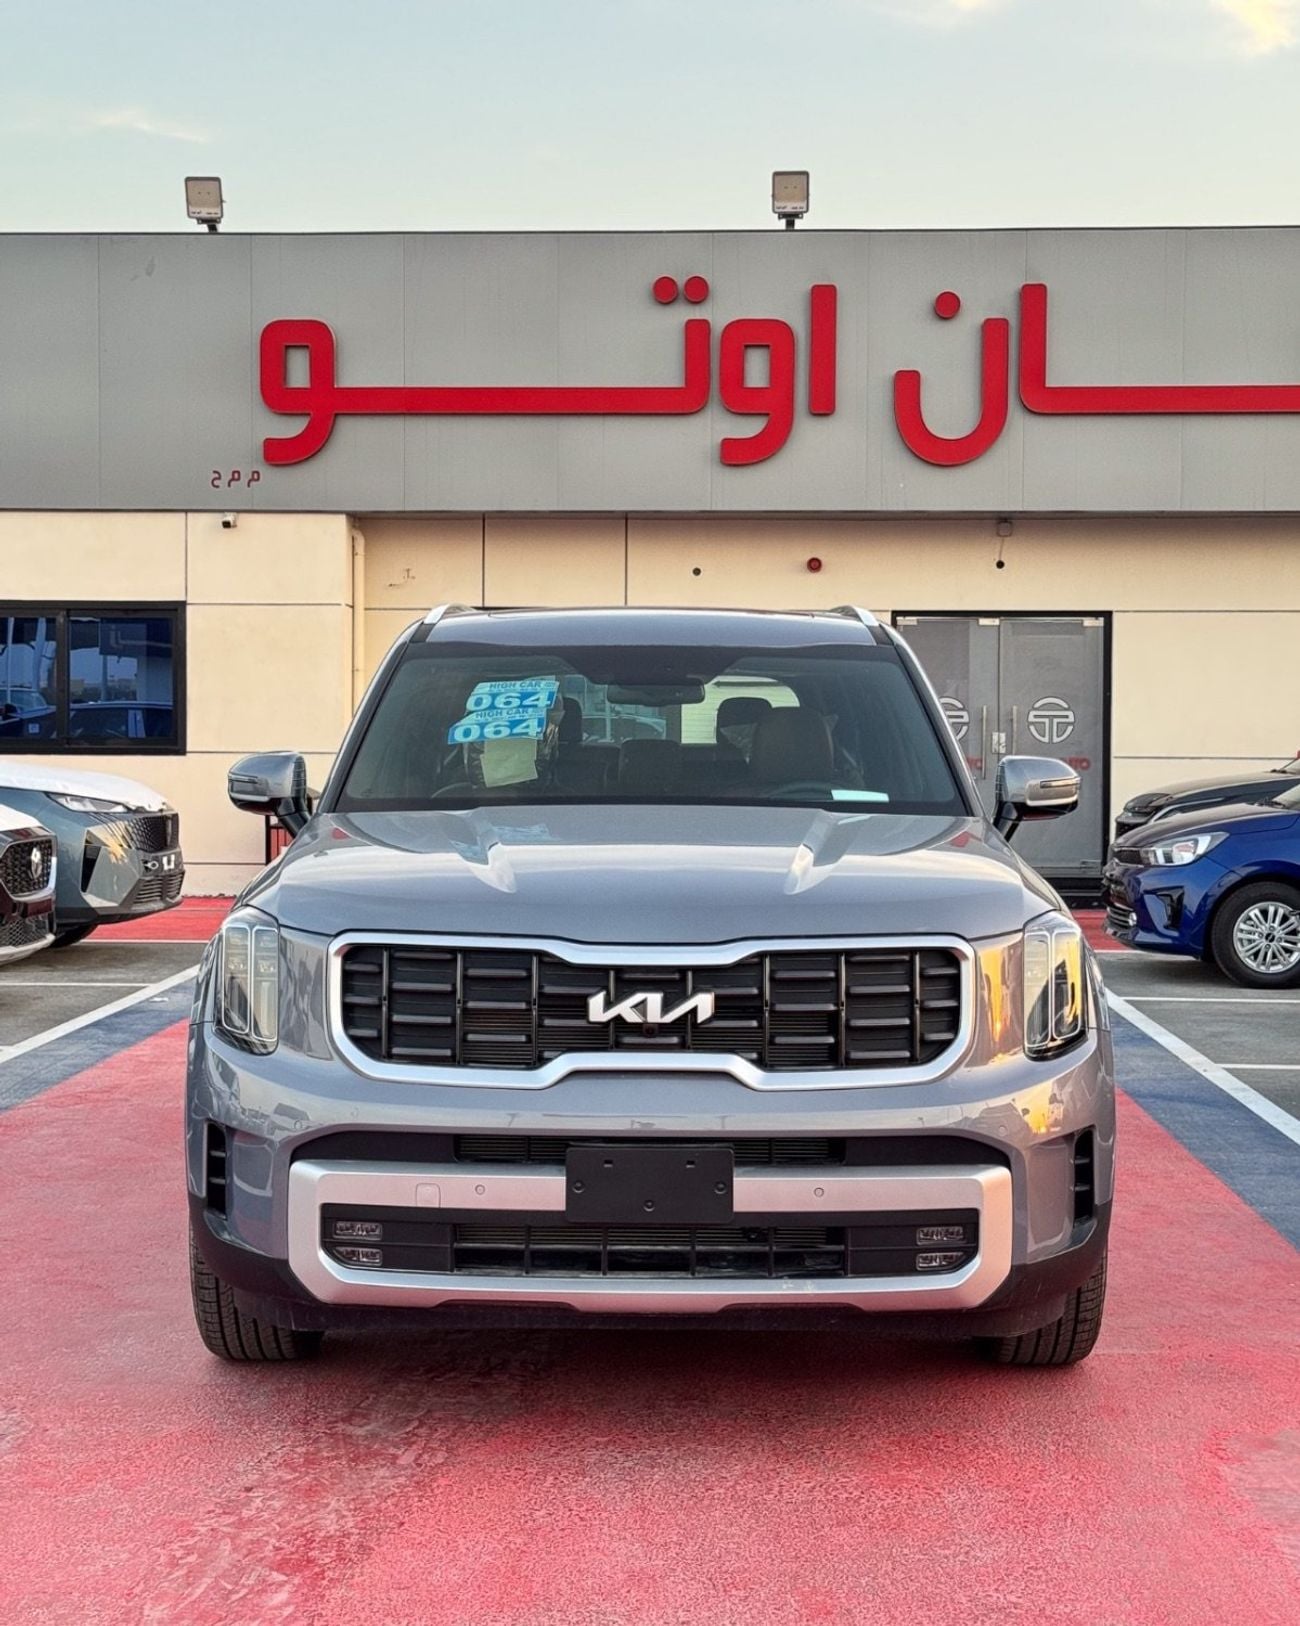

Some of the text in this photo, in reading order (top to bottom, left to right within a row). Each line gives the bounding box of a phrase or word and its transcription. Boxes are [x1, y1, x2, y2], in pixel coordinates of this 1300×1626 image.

[466, 691, 551, 712] 064
[454, 719, 541, 742] 064
[588, 990, 715, 1024] KIA
